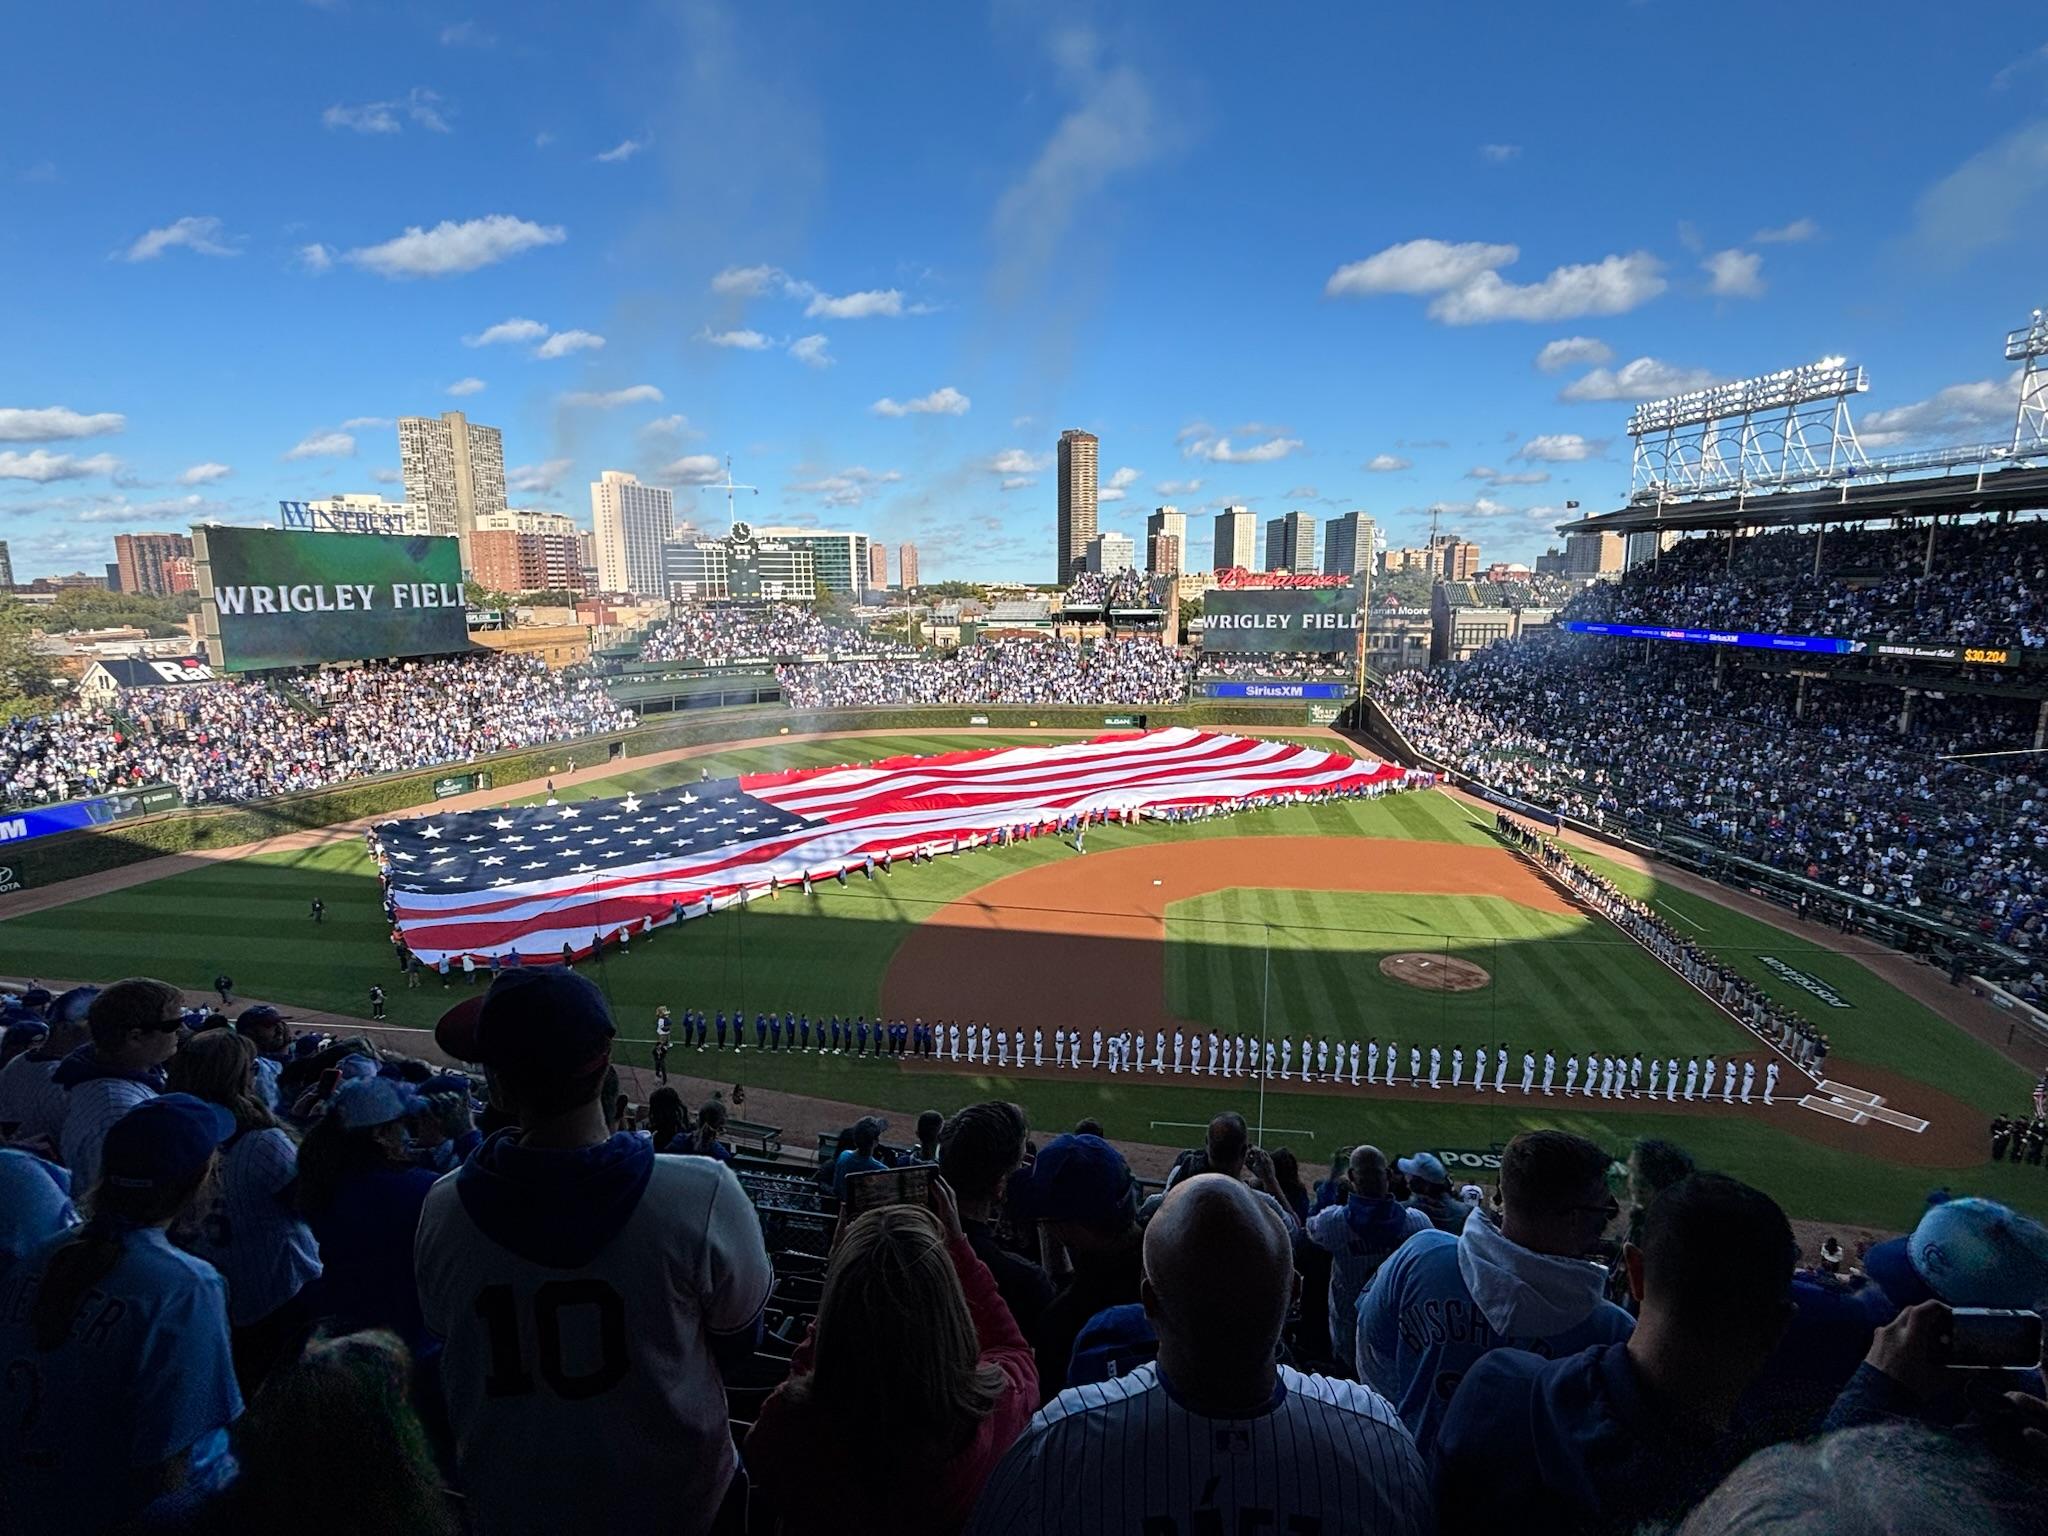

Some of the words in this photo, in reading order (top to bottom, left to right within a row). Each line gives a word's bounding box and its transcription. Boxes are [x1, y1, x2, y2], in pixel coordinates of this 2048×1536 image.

[279, 501, 408, 533] WINTRUST
[1214, 565, 1350, 588] Budweiser
[215, 585, 376, 615] WRIGLEY
[1398, 607, 1430, 615] Moore
[1203, 613, 1291, 629] WRIGLEY
[703, 658, 726, 667] YETI
[1246, 686, 1303, 696] SiriusXM
[1440, 1151, 1503, 1169] POS
[475, 1279, 632, 1399] 10
